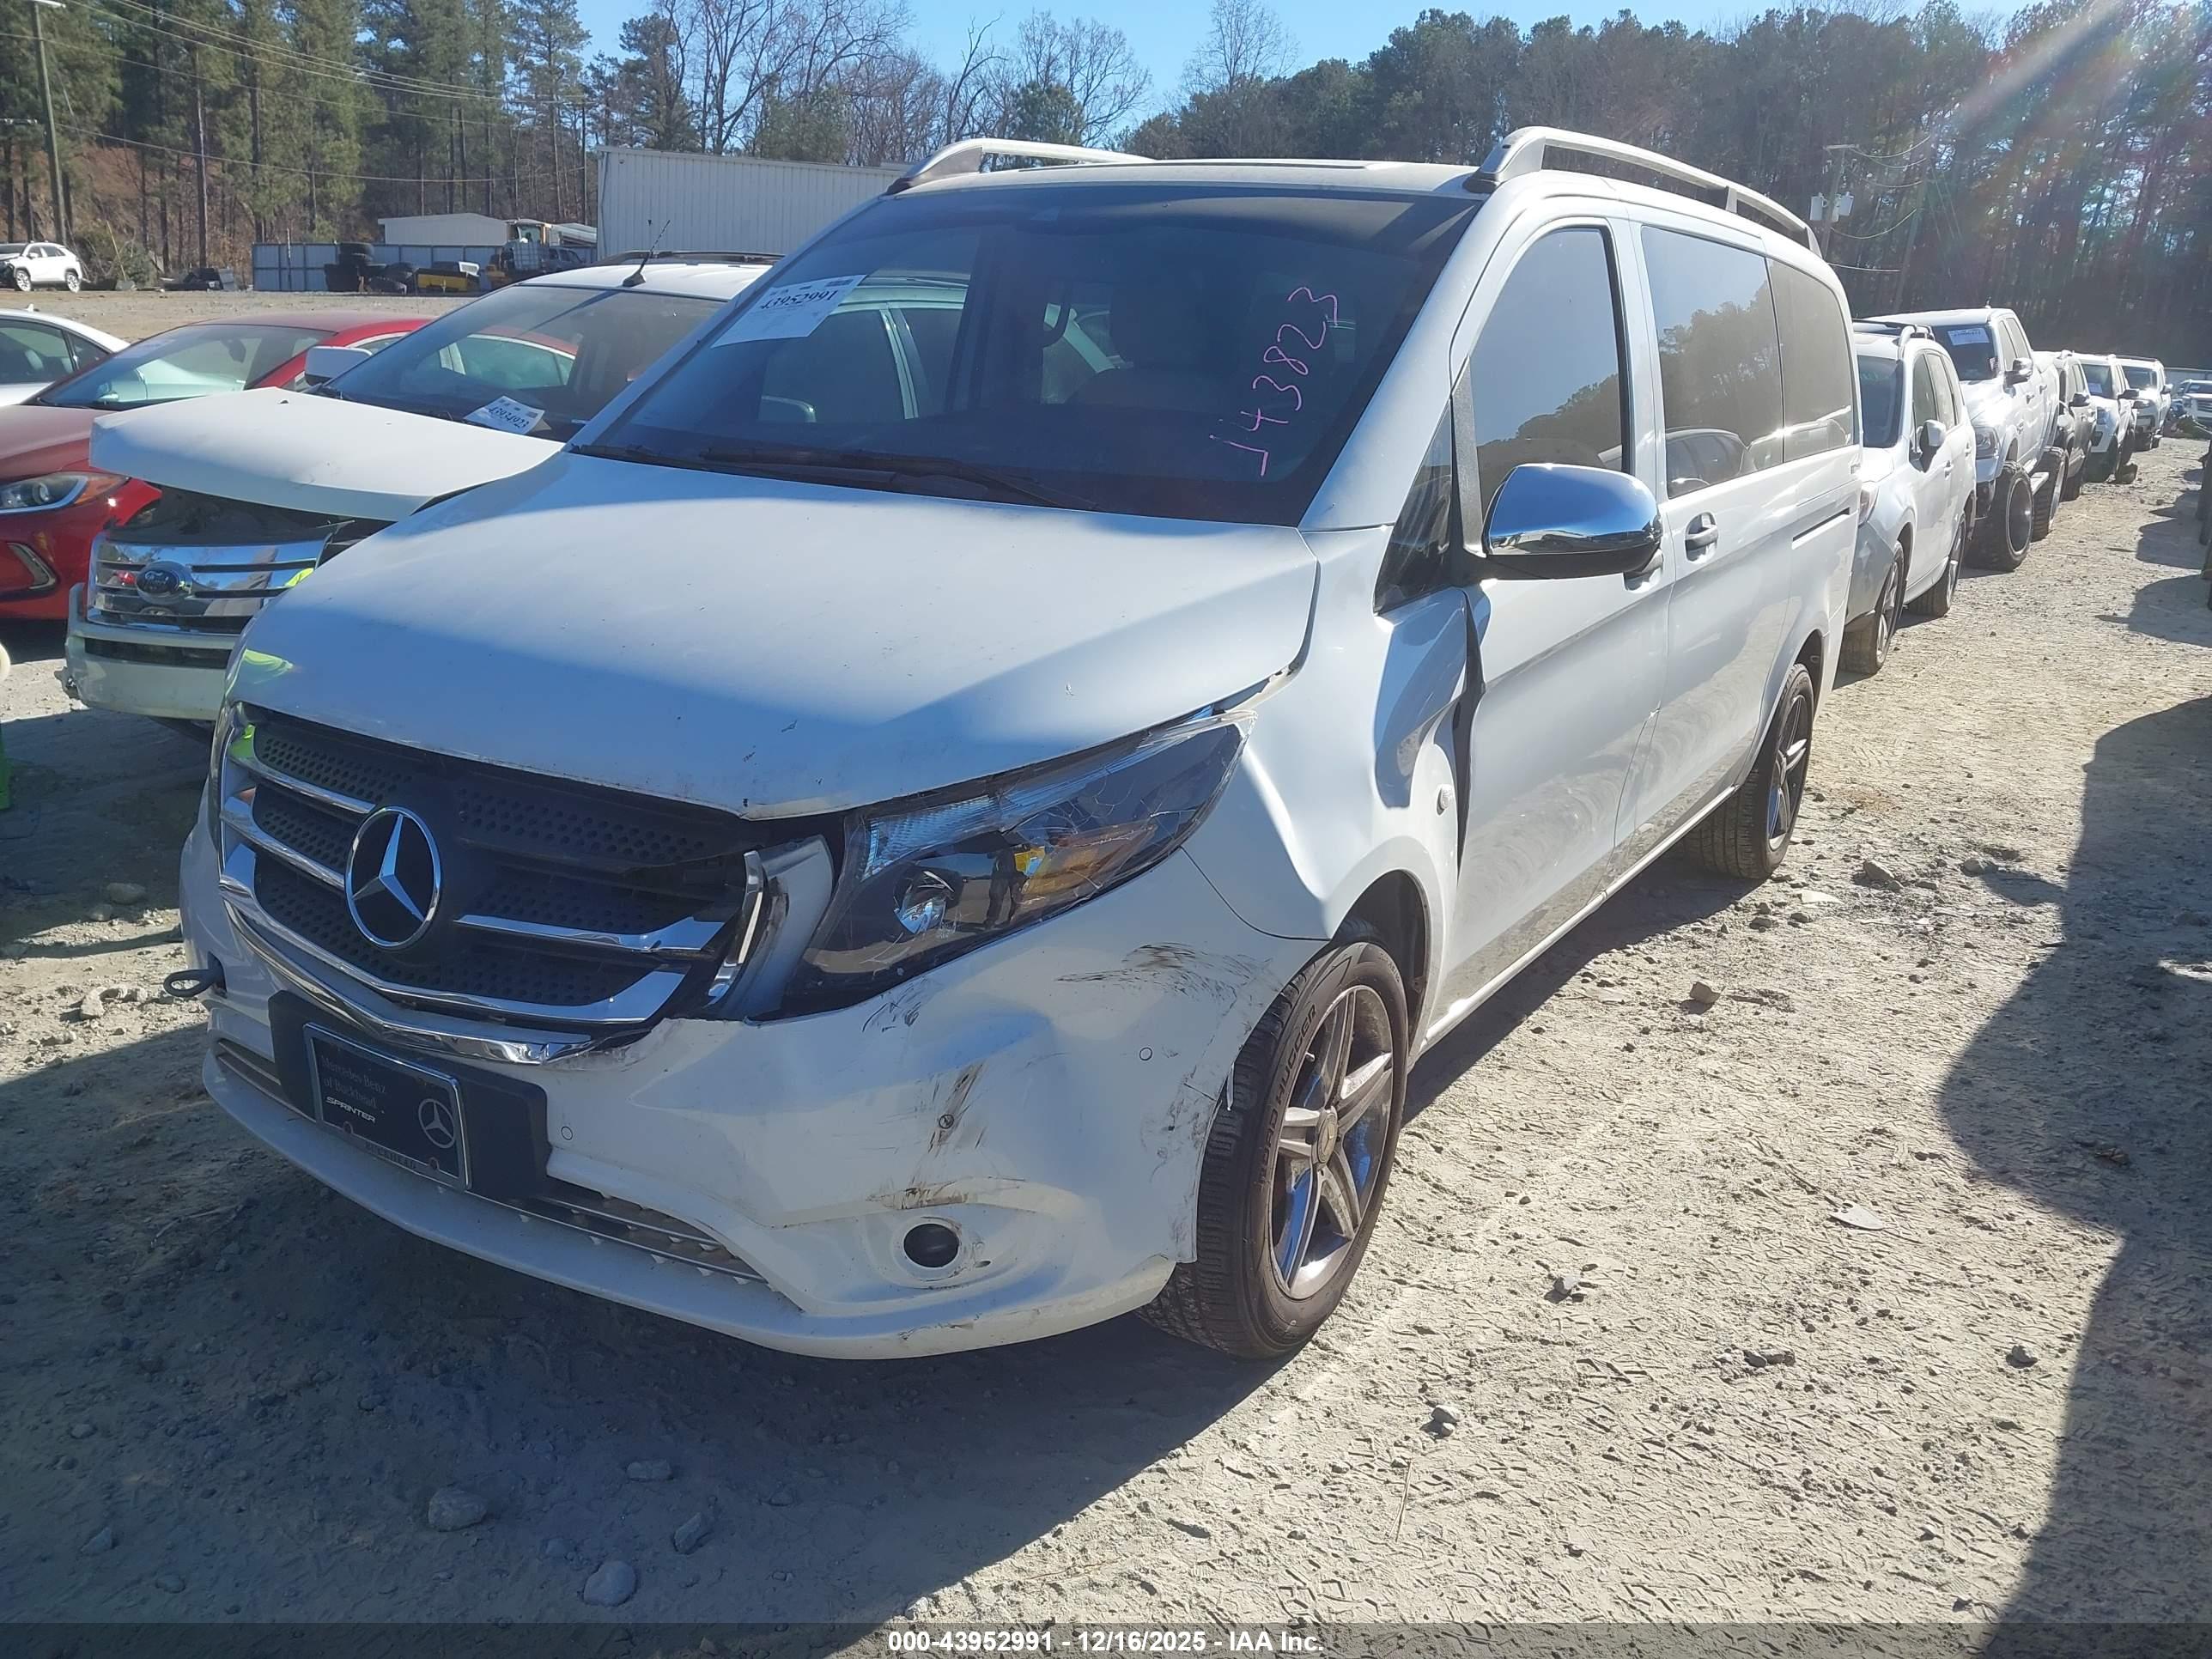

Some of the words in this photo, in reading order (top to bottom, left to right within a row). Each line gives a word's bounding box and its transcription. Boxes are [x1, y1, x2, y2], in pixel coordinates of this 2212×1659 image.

[761, 289, 838, 309] 43952991
[1275, 1003, 1316, 1105] HUGGER
[325, 1096, 376, 1123] SPRINTER
